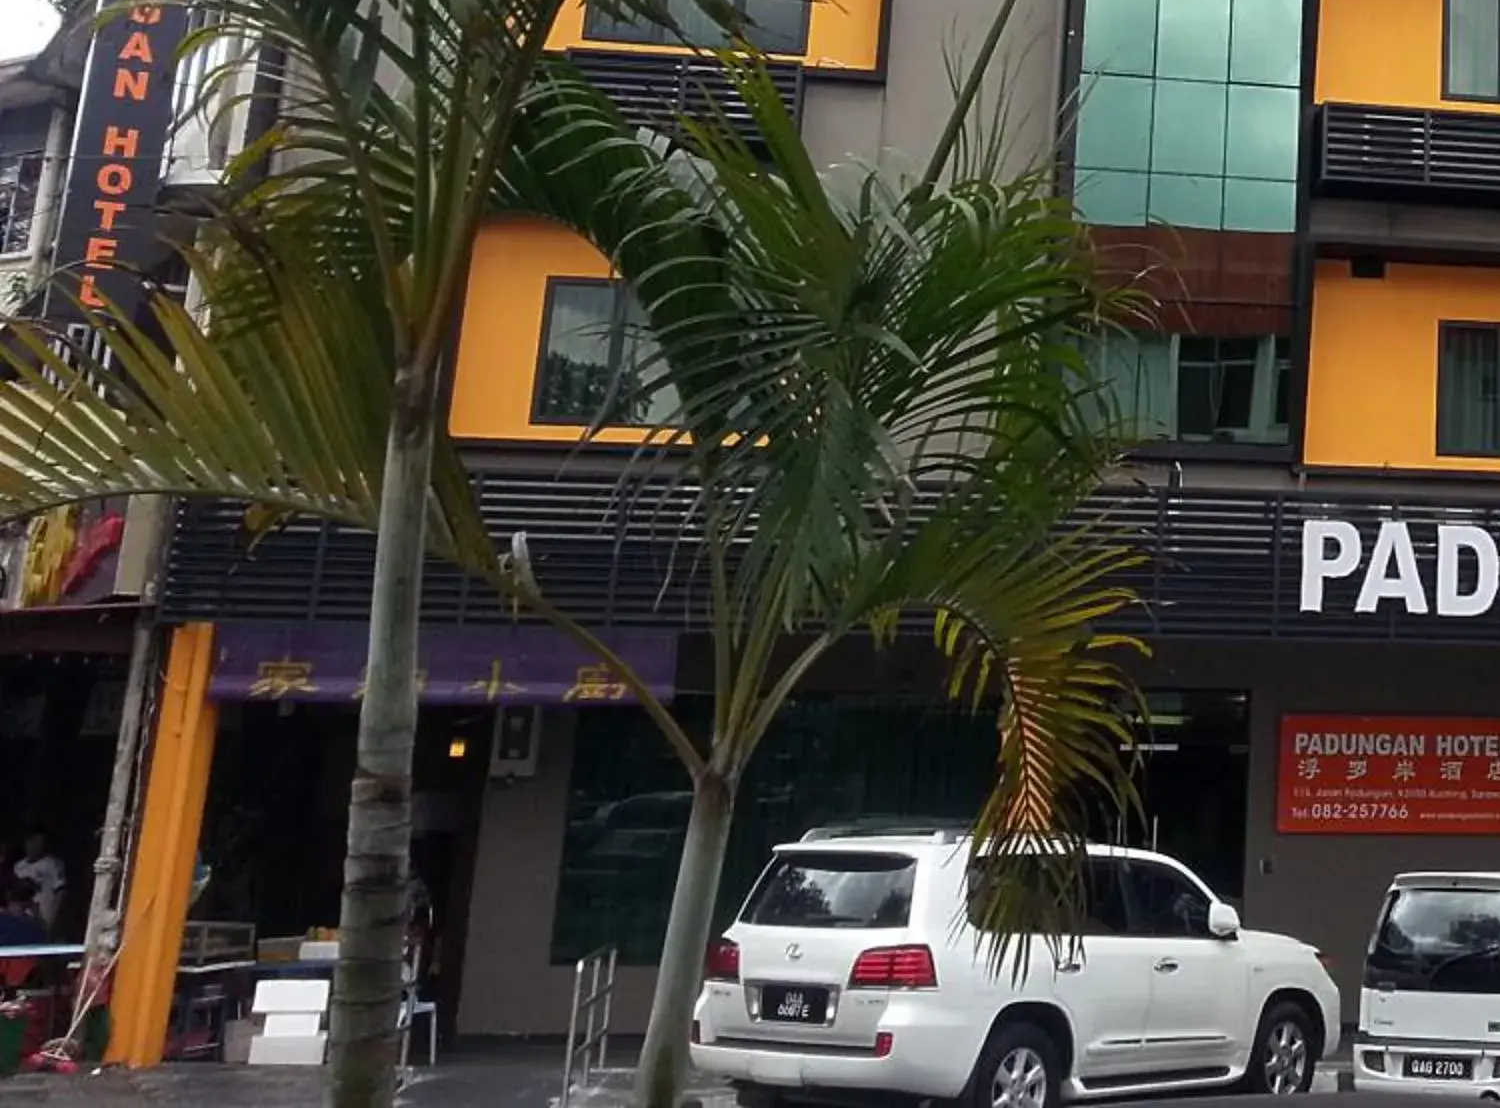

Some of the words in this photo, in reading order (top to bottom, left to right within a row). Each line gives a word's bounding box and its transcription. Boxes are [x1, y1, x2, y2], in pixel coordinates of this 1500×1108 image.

[80, 125, 141, 310] HOTEL
[1294, 732, 1425, 755] PADUNGAN
[1311, 803, 1409, 819] 082-257766
